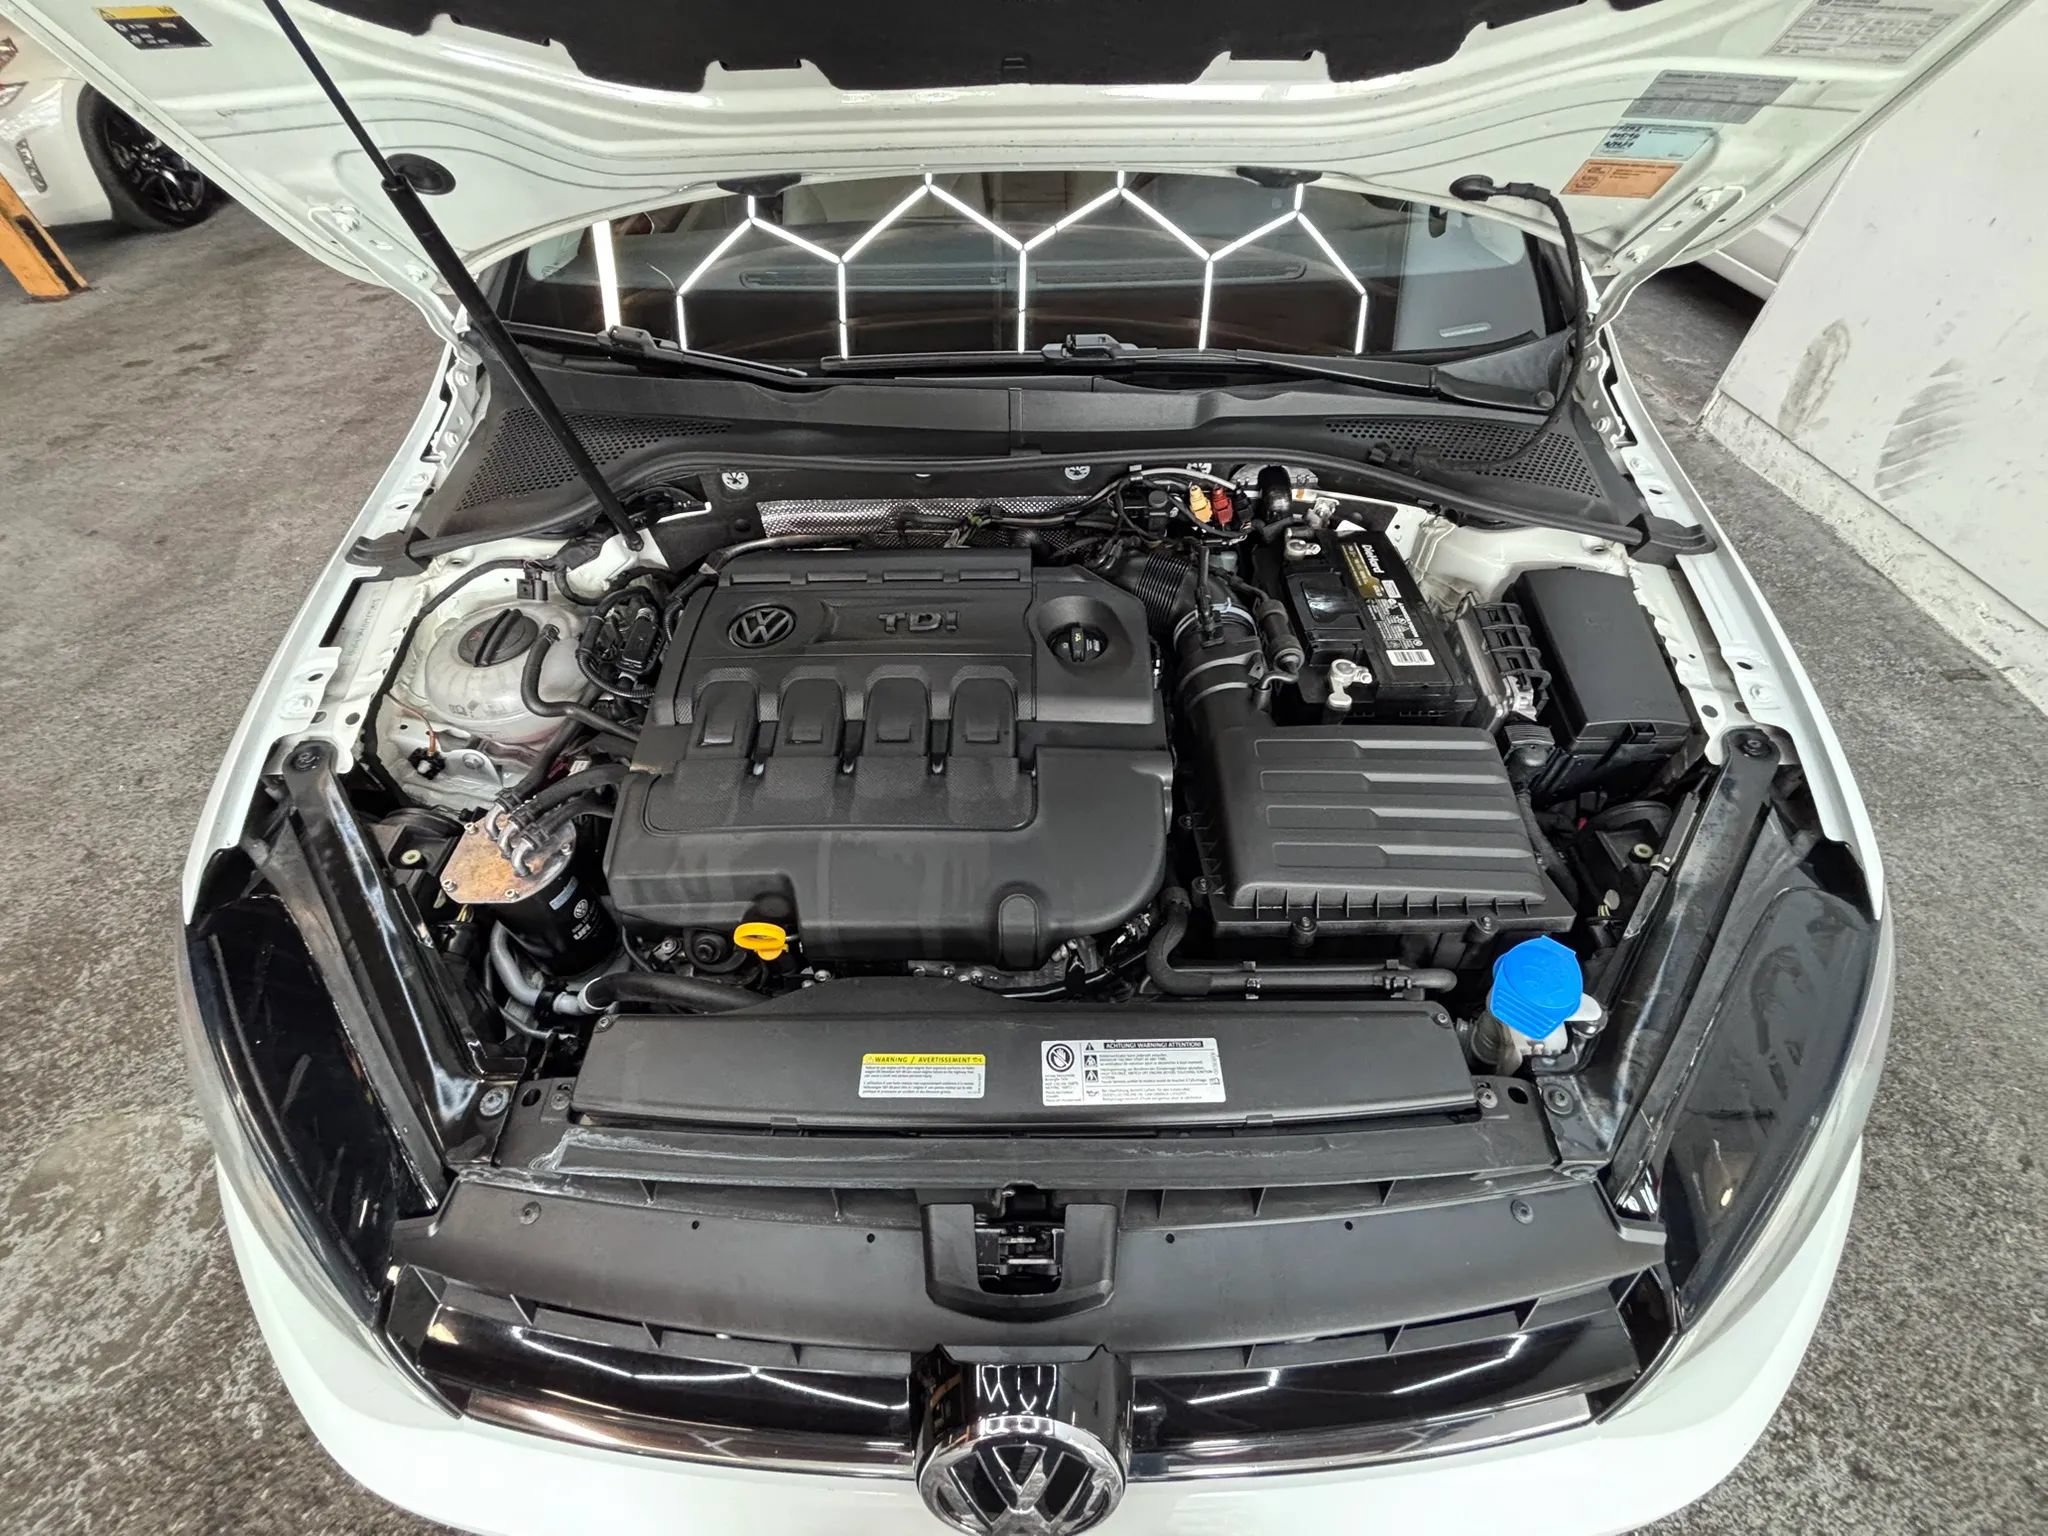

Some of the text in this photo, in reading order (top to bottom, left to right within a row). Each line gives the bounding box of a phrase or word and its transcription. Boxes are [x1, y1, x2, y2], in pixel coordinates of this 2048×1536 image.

[1361, 544, 1385, 573] DieHard
[731, 605, 795, 648] VW
[877, 611, 960, 634] TDI
